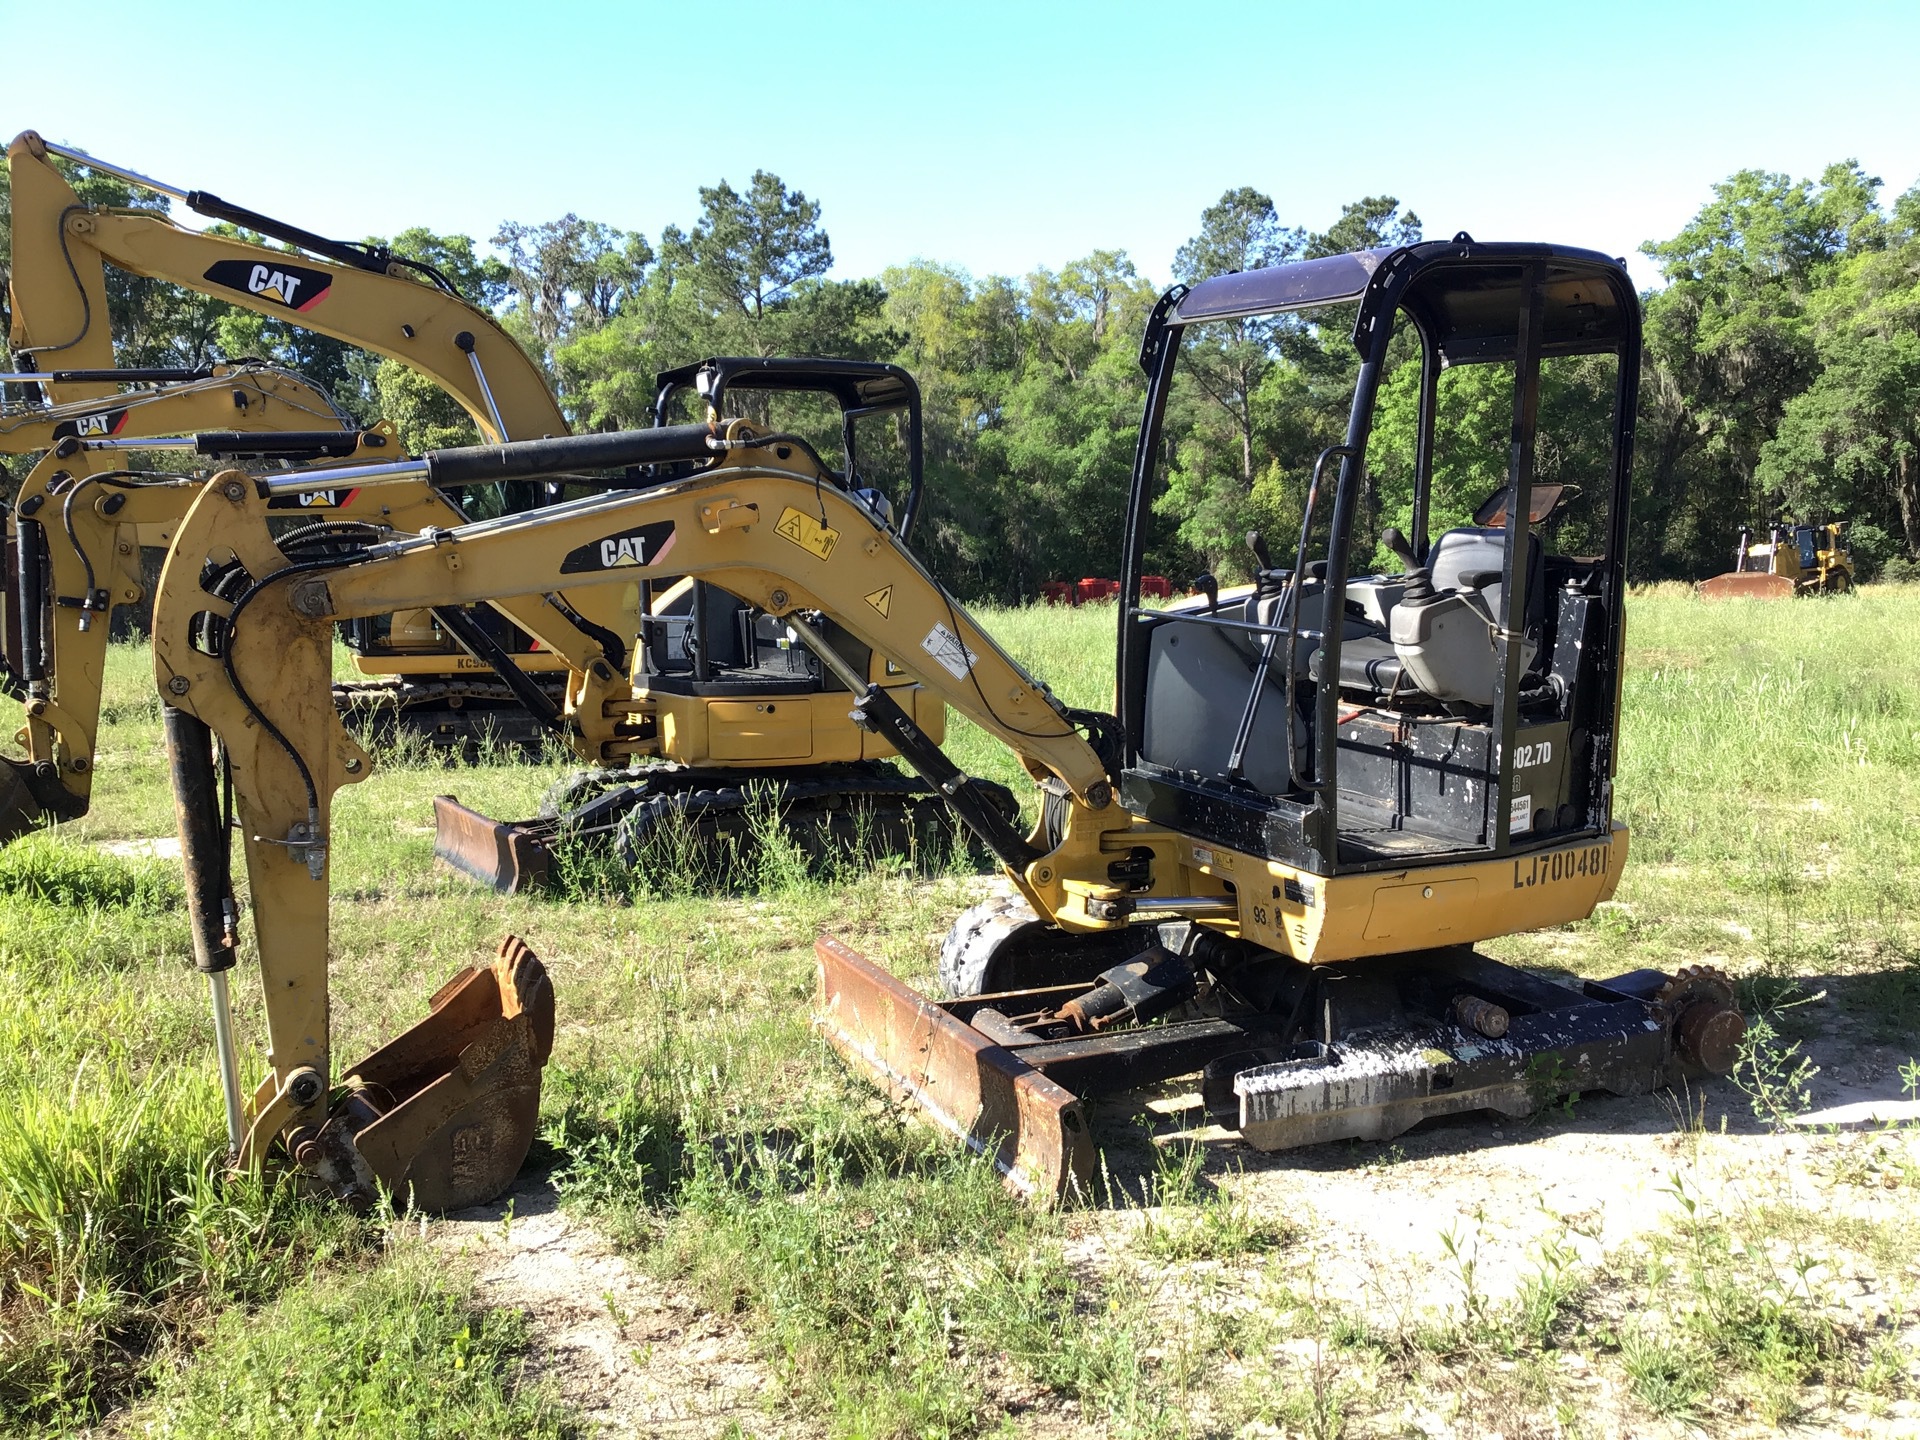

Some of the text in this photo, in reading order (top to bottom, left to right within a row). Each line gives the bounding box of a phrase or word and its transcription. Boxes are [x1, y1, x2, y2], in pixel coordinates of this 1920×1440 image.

[248, 264, 301, 305] CAT
[76, 415, 109, 437] CAT
[600, 536, 646, 567] CAT
[946, 632, 972, 659] WARNNG
[1253, 905, 1267, 925] 93
